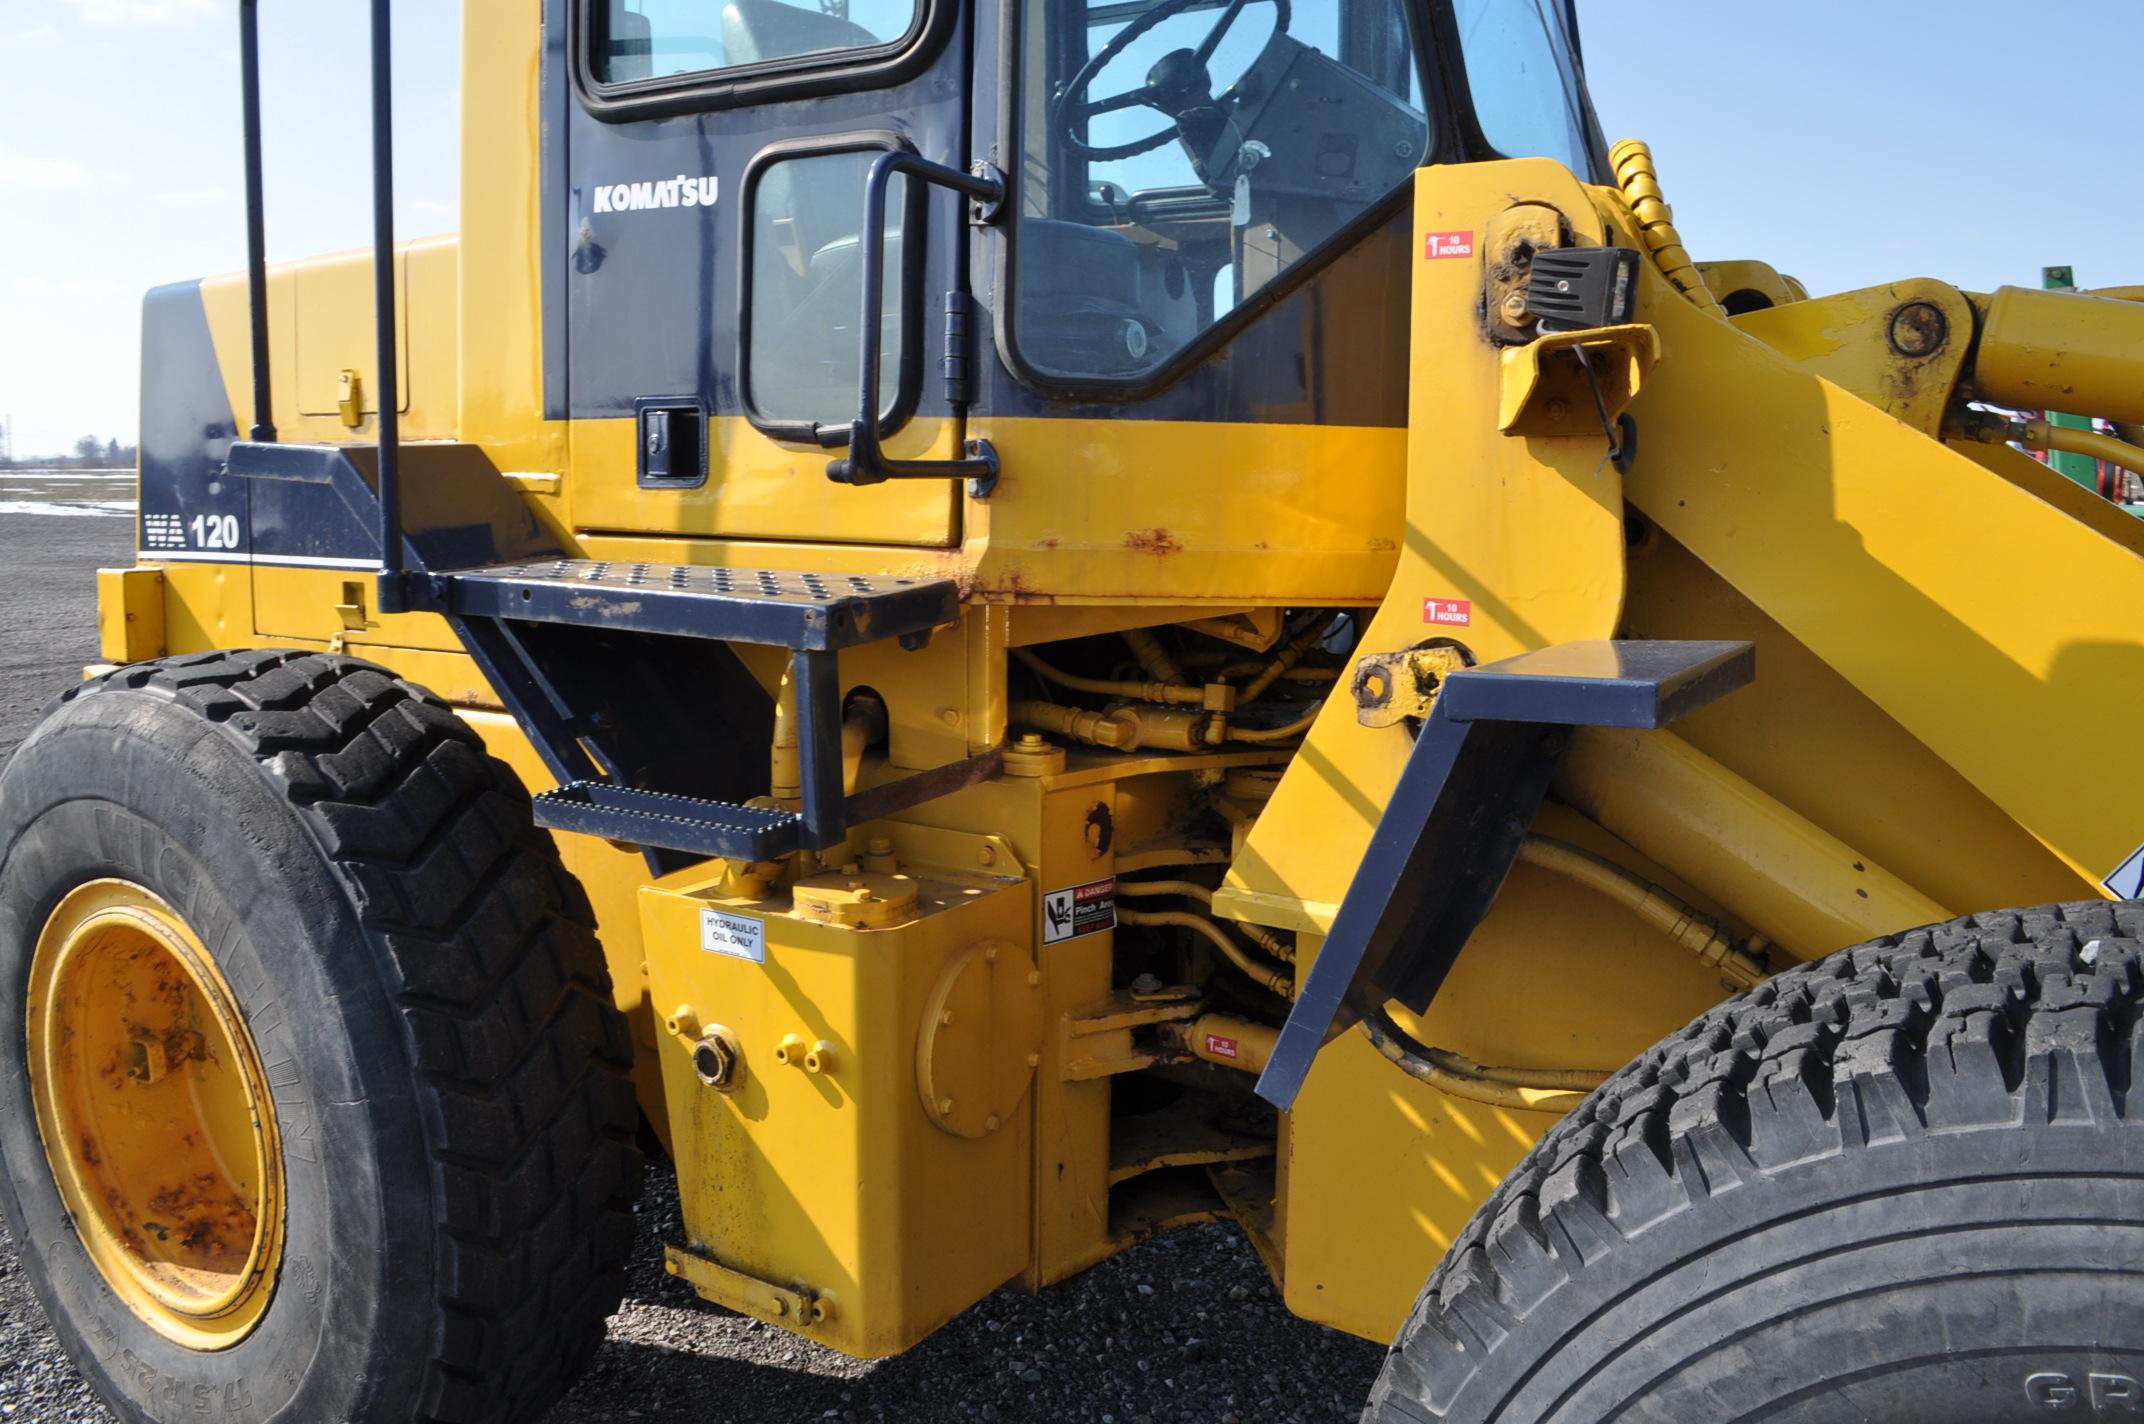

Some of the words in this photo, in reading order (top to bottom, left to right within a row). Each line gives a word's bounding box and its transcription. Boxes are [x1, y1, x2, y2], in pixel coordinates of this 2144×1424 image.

[593, 174, 719, 213] KOMATSU
[1449, 235, 1460, 245] 10
[1439, 245, 1471, 255] HOURS
[192, 514, 240, 548] 120
[1447, 603, 1457, 613] 10
[1437, 612, 1468, 623] HOURS
[1075, 903, 1097, 916] Pinch
[707, 917, 759, 936] HYDRAULIC
[712, 931, 728, 943] OIL
[730, 935, 754, 948] ONLY
